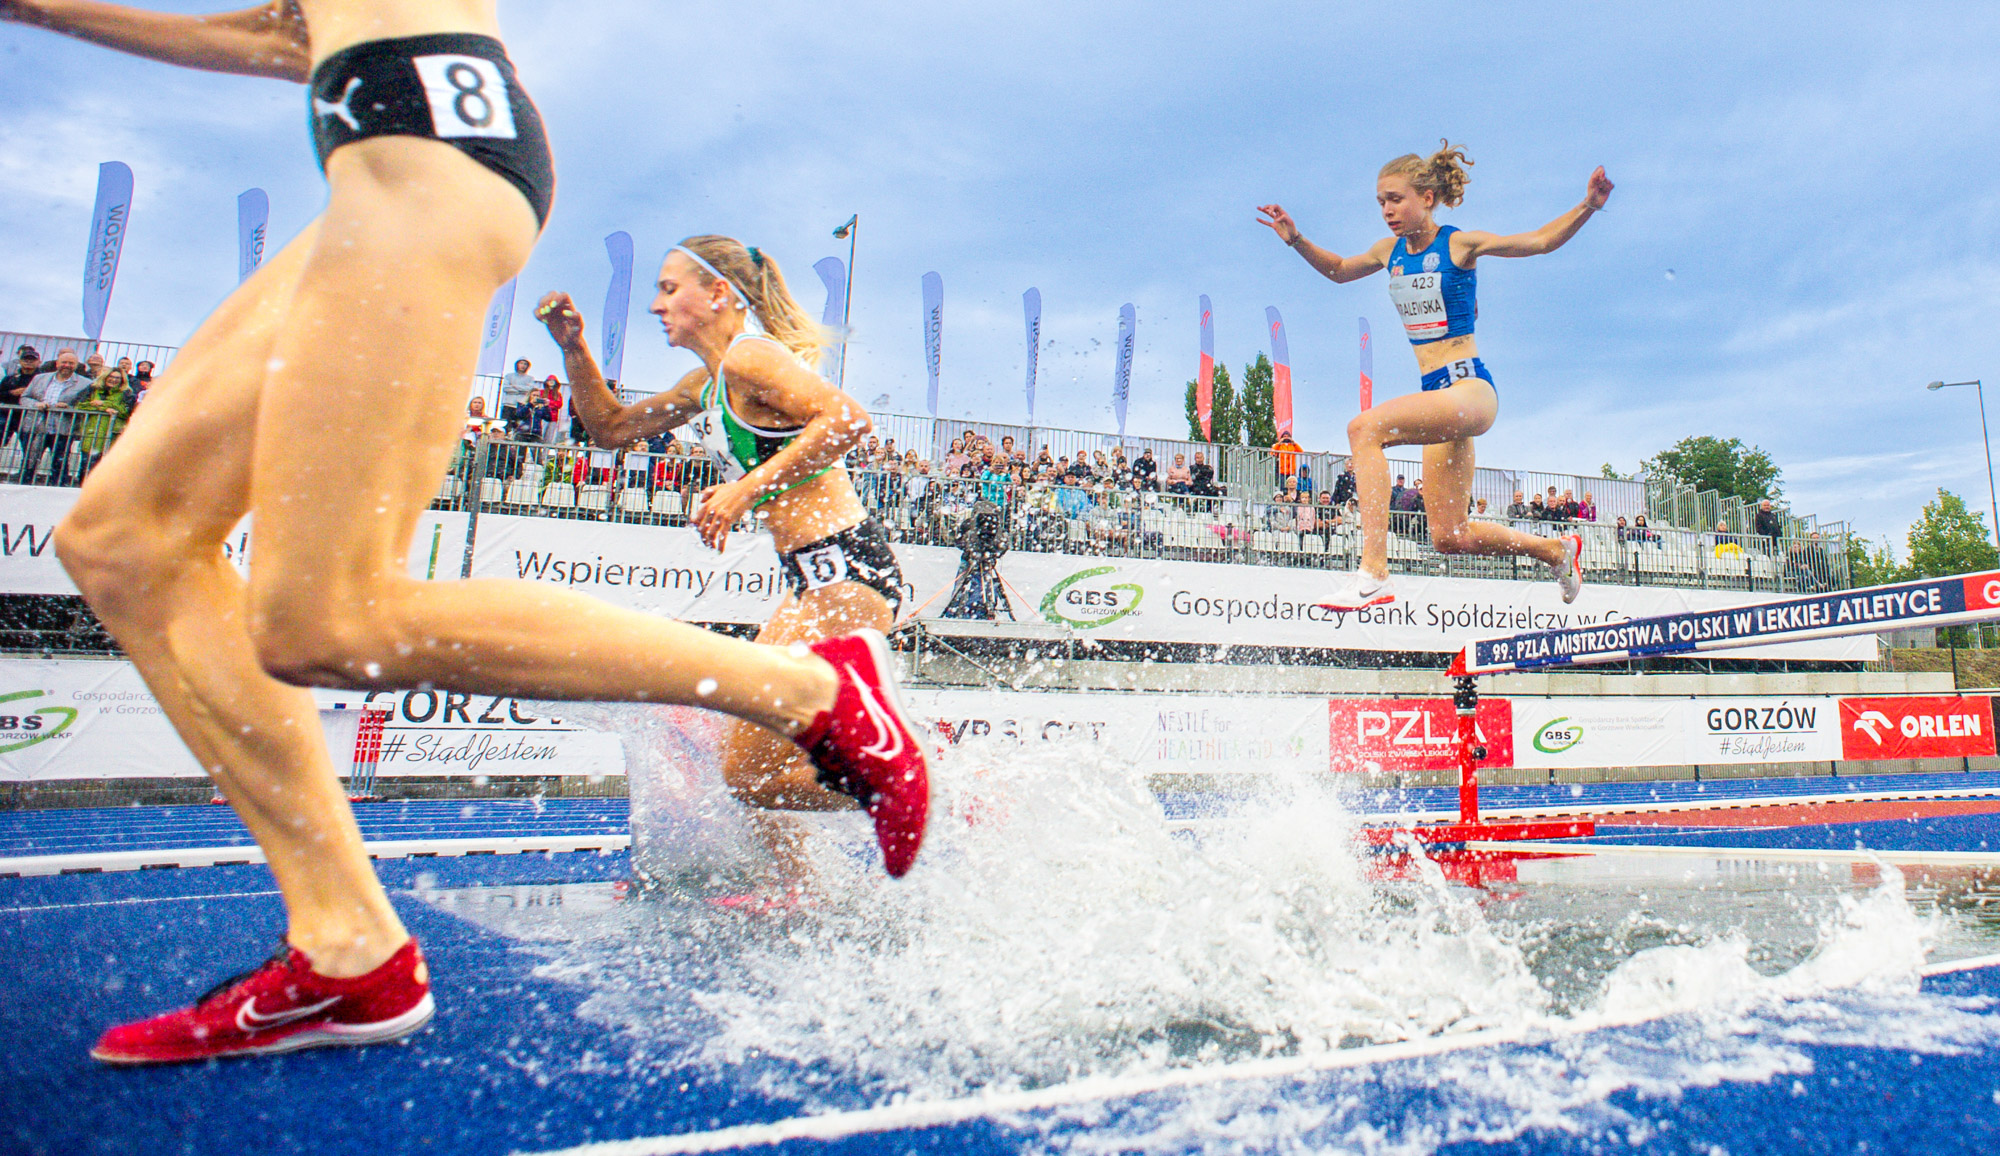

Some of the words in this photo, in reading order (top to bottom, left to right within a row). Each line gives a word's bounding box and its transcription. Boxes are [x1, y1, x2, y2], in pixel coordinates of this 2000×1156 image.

[445, 62, 494, 128] 8
[1412, 276, 1434, 290] 423
[1454, 360, 1469, 378] 5
[515, 550, 714, 598] Wspieramy
[1066, 589, 1118, 606] GBS
[1172, 590, 1347, 629] Gospodarczy
[1358, 601, 1417, 626] Bank
[1427, 603, 1568, 633] Spółdzielczy
[1492, 642, 1513, 662] 99.
[1516, 640, 1550, 660] PZLA
[1554, 624, 1664, 656] MISTRZOSTWA
[1668, 615, 1729, 642] POLSKI
[1733, 612, 1752, 635] W
[1757, 601, 1830, 632] LEKKIEJ
[1836, 588, 1942, 623] ATLETYCE
[365, 690, 562, 725] GORZ
[1707, 701, 1816, 731] GORZÓW
[0, 715, 43, 731] BS
[1213, 717, 1231, 733] for
[1900, 714, 1981, 738] ORLEN
[1545, 731, 1571, 740] GBS
[381, 733, 558, 770] #StądJestem
[1719, 736, 1806, 760] #StądJestem
